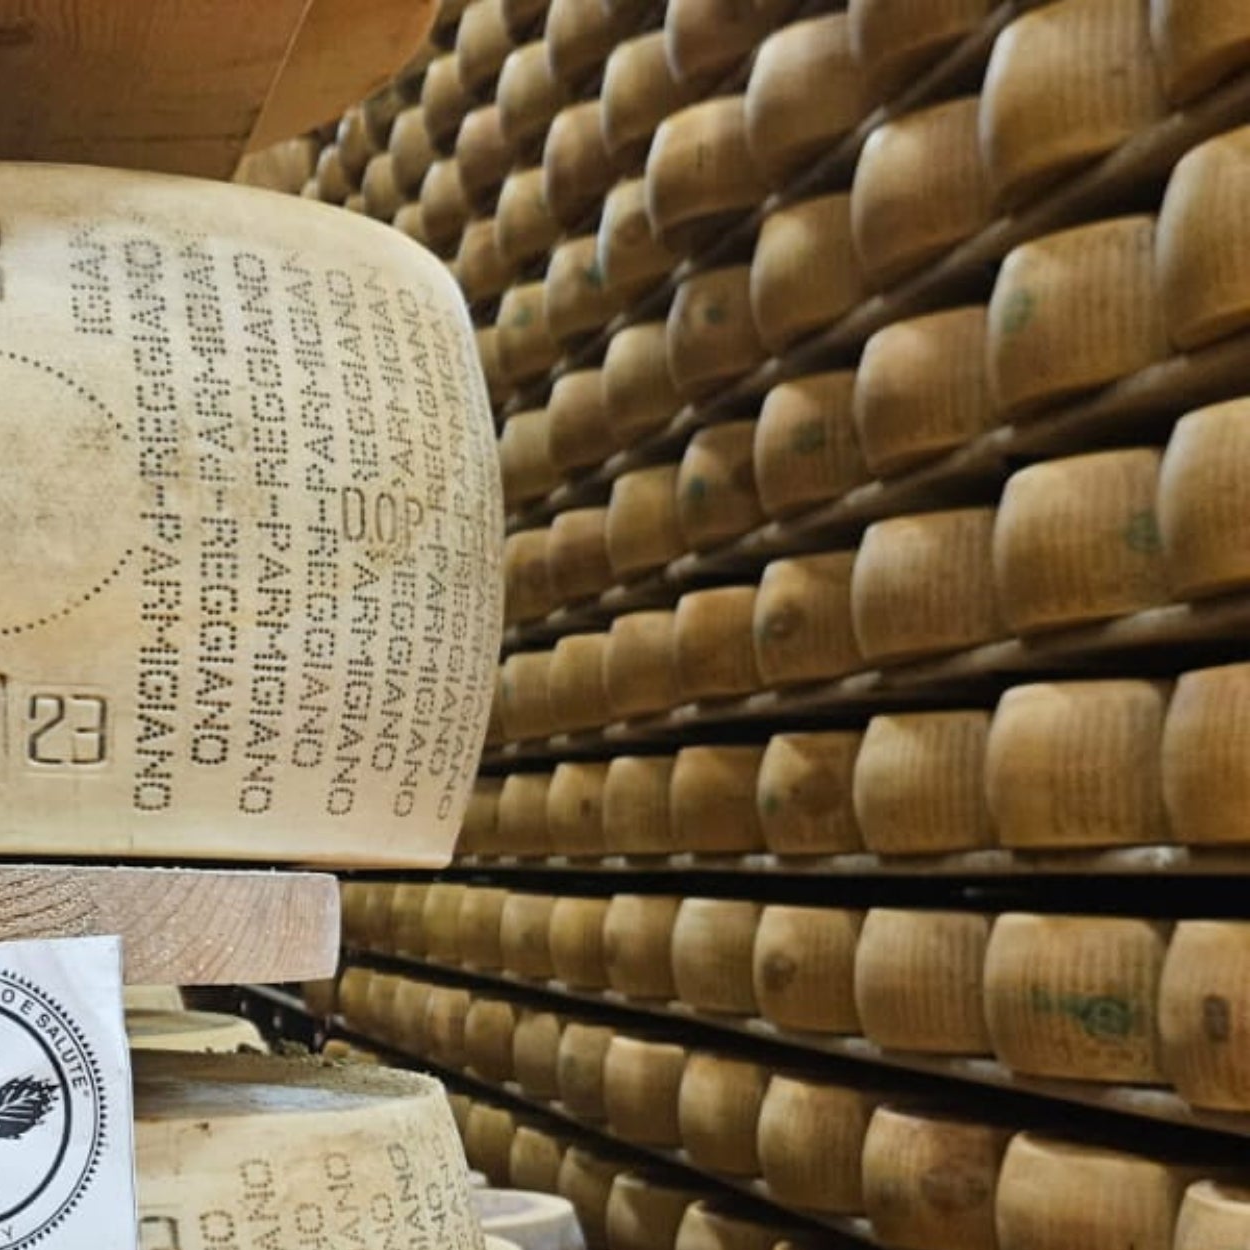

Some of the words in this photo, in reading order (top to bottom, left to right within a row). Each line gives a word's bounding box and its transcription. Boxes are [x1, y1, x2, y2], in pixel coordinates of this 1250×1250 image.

[124, 239, 180, 480] REGGIANO
[234, 252, 290, 488] REGGIANO
[398, 287, 447, 512] REGGIANO
[28, 692, 107, 764] 23
[133, 512, 181, 812] PARMIGIANO
[191, 517, 238, 765] REGGIANO
[239, 521, 291, 814] PARMIGIANO
[291, 526, 338, 768] REGGIANO
[393, 544, 449, 818] PARMIGIANO
[18, 994, 35, 1016] E
